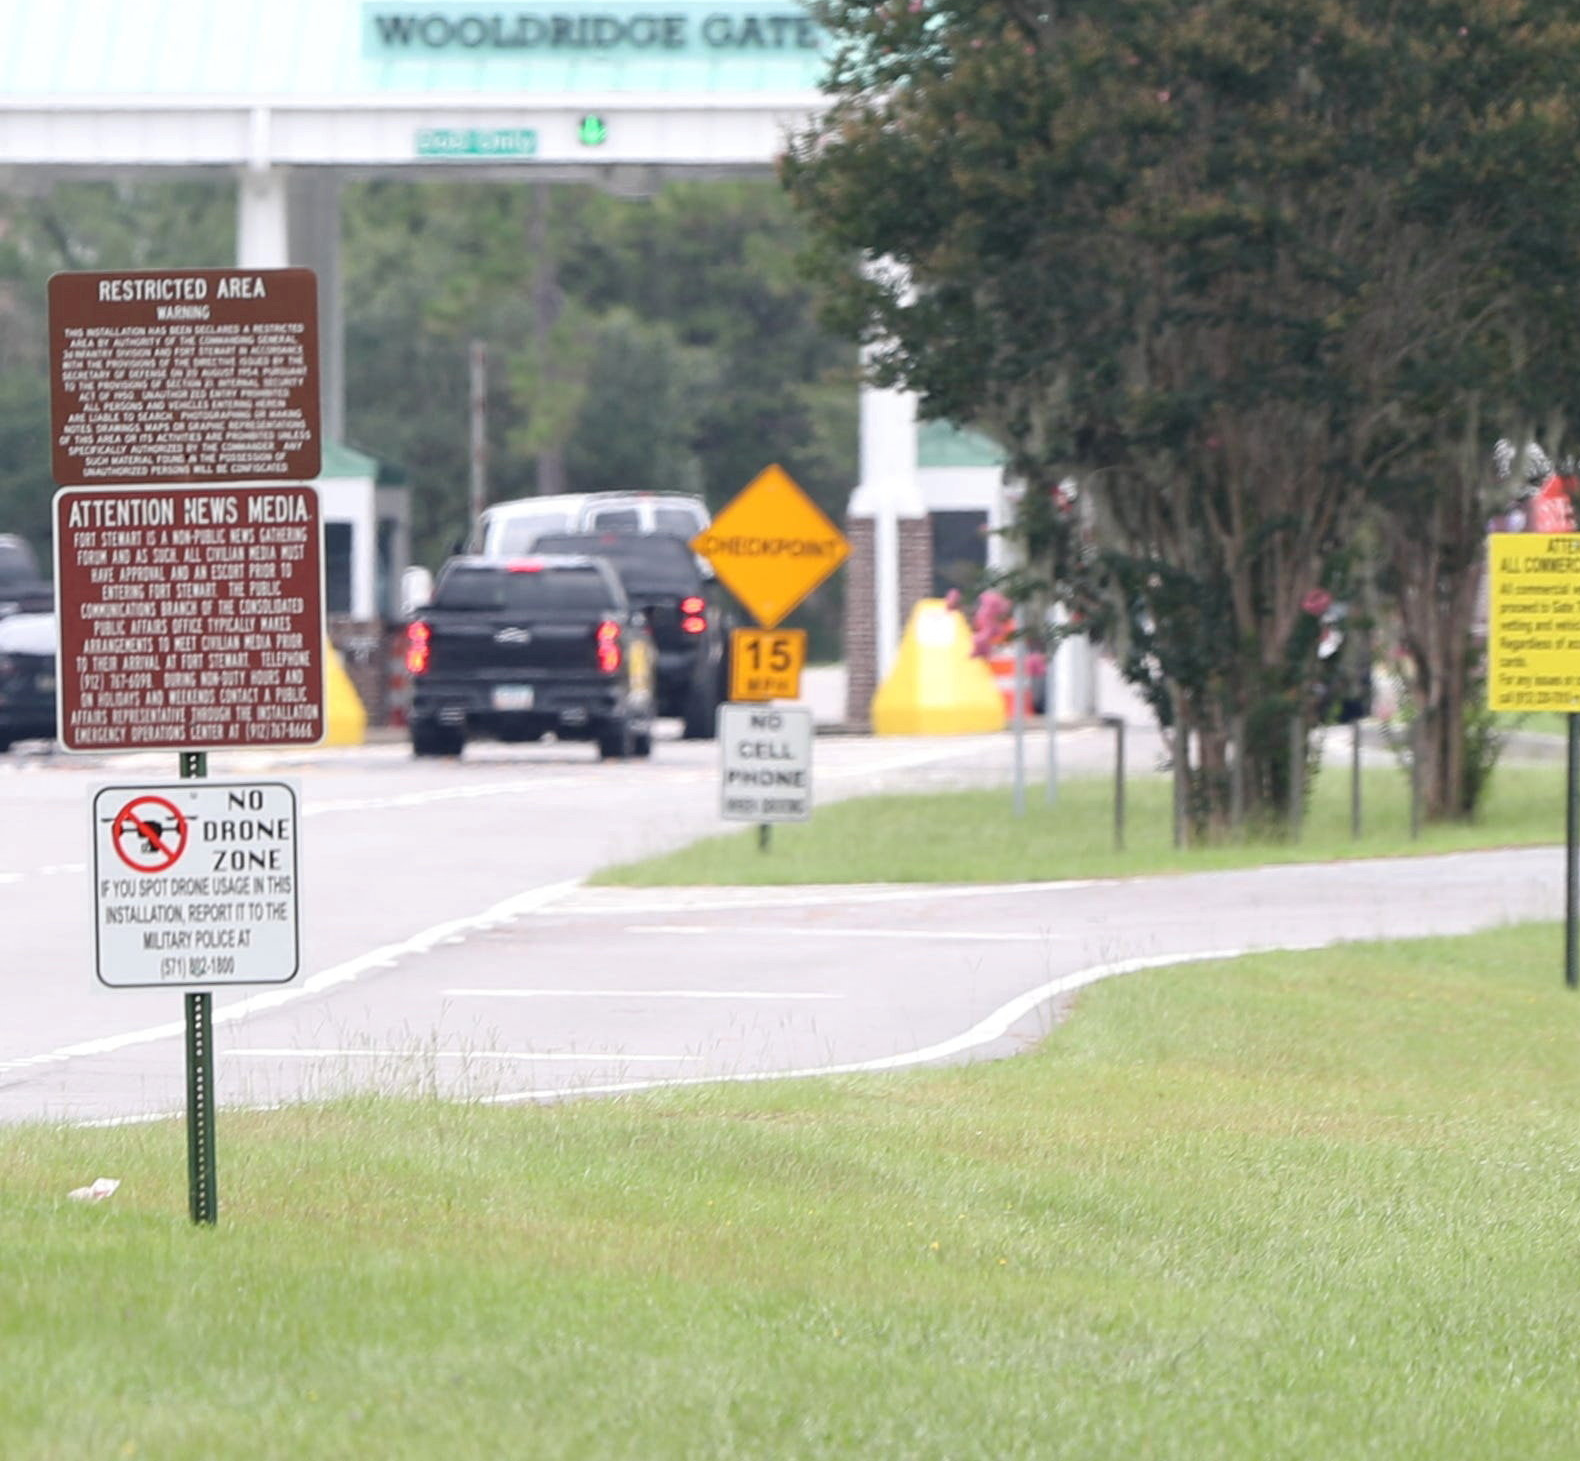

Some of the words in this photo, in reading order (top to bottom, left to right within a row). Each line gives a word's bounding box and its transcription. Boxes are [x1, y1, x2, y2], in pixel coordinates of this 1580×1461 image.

[375, 14, 687, 49] WOOLDRIDGE
[702, 16, 820, 49] GATE
[99, 279, 207, 302] RESTRICTED
[217, 278, 266, 299] AREA
[157, 305, 210, 321] WARNING
[69, 498, 174, 528] ATTENTION
[184, 497, 238, 524] NEWS
[248, 495, 308, 523] MEDIA
[74, 533, 95, 548] FORT
[102, 531, 141, 546] STEWART
[147, 530, 155, 545] IS
[161, 530, 167, 545] A
[173, 528, 225, 545] NON-PUBLIC
[231, 528, 254, 543] NEWS
[260, 526, 307, 543] GATHERING
[705, 536, 835, 558] CHECKPOINT
[78, 550, 107, 565] FORUM
[113, 549, 130, 564] AND
[136, 549, 148, 563] AS
[184, 548, 201, 562] ALL
[207, 547, 244, 562] CIVILIAN
[250, 545, 275, 561] MEDIA
[281, 544, 304, 560] MUST
[1501, 557, 1520, 573] ALL
[91, 568, 113, 583] HAVE
[120, 566, 165, 581] APPROVAL
[171, 565, 189, 580] AND
[195, 565, 207, 580] AN
[212, 564, 243, 579] ESCORT
[249, 564, 276, 578] PRIOR
[281, 562, 292, 577] TO
[102, 585, 144, 600] ENTERING
[149, 584, 170, 599] FORT
[229, 582, 244, 597] THE
[250, 580, 281, 596] PUBLIC
[81, 602, 155, 619] COMMUNICATIONS
[161, 601, 197, 617] BRANCH
[202, 601, 213, 615] OF
[219, 600, 234, 615] THE
[240, 598, 303, 614] CONSOLIDATED
[94, 620, 125, 636] PUBLIC
[131, 619, 167, 634] AFFAIRS
[173, 618, 203, 634] OFFICE
[208, 617, 255, 633] TYPICALLY
[261, 616, 291, 631] MAKES
[84, 638, 153, 654] ARRANGEMENTS
[159, 637, 169, 652] TO
[175, 637, 196, 651] MEET
[201, 635, 239, 651] CIVILIAN
[245, 634, 271, 650] MEDIA
[277, 633, 302, 649] PRIOR
[77, 657, 87, 672] TO
[93, 656, 117, 671] THEIR
[123, 656, 160, 671] ARRIVAL
[165, 655, 176, 669] AT
[182, 654, 203, 669] FORT
[262, 651, 310, 667] TELEPHONE
[747, 640, 791, 671] 15
[81, 674, 104, 692] (912)
[164, 673, 195, 688] DURING
[201, 671, 245, 687] NON-DUTY
[251, 670, 279, 685] HOURS
[285, 669, 303, 684] AND
[81, 692, 93, 707] ON
[98, 691, 139, 707] HOLIDAYS
[145, 690, 163, 706] AND
[169, 689, 214, 705] WEEKENDS
[220, 687, 258, 703] CONTACT
[264, 687, 271, 702] A
[276, 686, 307, 702] PUBLIC
[71, 711, 107, 726] AFFAIRS
[113, 707, 185, 725] REPRESENTATIVE
[191, 707, 231, 723] THROUGH
[236, 706, 252, 722] THE
[257, 704, 318, 720] INSTALLATION
[751, 716, 782, 730] NO
[75, 727, 125, 743] EMERGENCY
[131, 725, 185, 741] OPERATIONS
[191, 724, 223, 740] CENTER
[228, 724, 240, 739] AT
[739, 742, 794, 760] CELL
[729, 769, 806, 788] PHONE
[228, 790, 263, 811] NO
[204, 819, 289, 842] DRONE
[213, 850, 281, 871] ZONE
[101, 880, 110, 898] IF
[113, 880, 136, 897] YOU
[139, 879, 168, 896] SPOT
[171, 877, 209, 895] DRONE
[213, 877, 250, 895] USAGE
[254, 877, 264, 894] IN
[268, 876, 291, 894] THIS
[106, 905, 185, 924] INSTALLATION,
[189, 904, 233, 922] REPORT
[236, 903, 245, 920] IT
[250, 903, 263, 920] TO
[267, 902, 287, 920] THE
[144, 931, 191, 949] MILITARY
[195, 930, 235, 948] POLICE
[237, 930, 251, 947] AT
[161, 958, 186, 979] (571)
